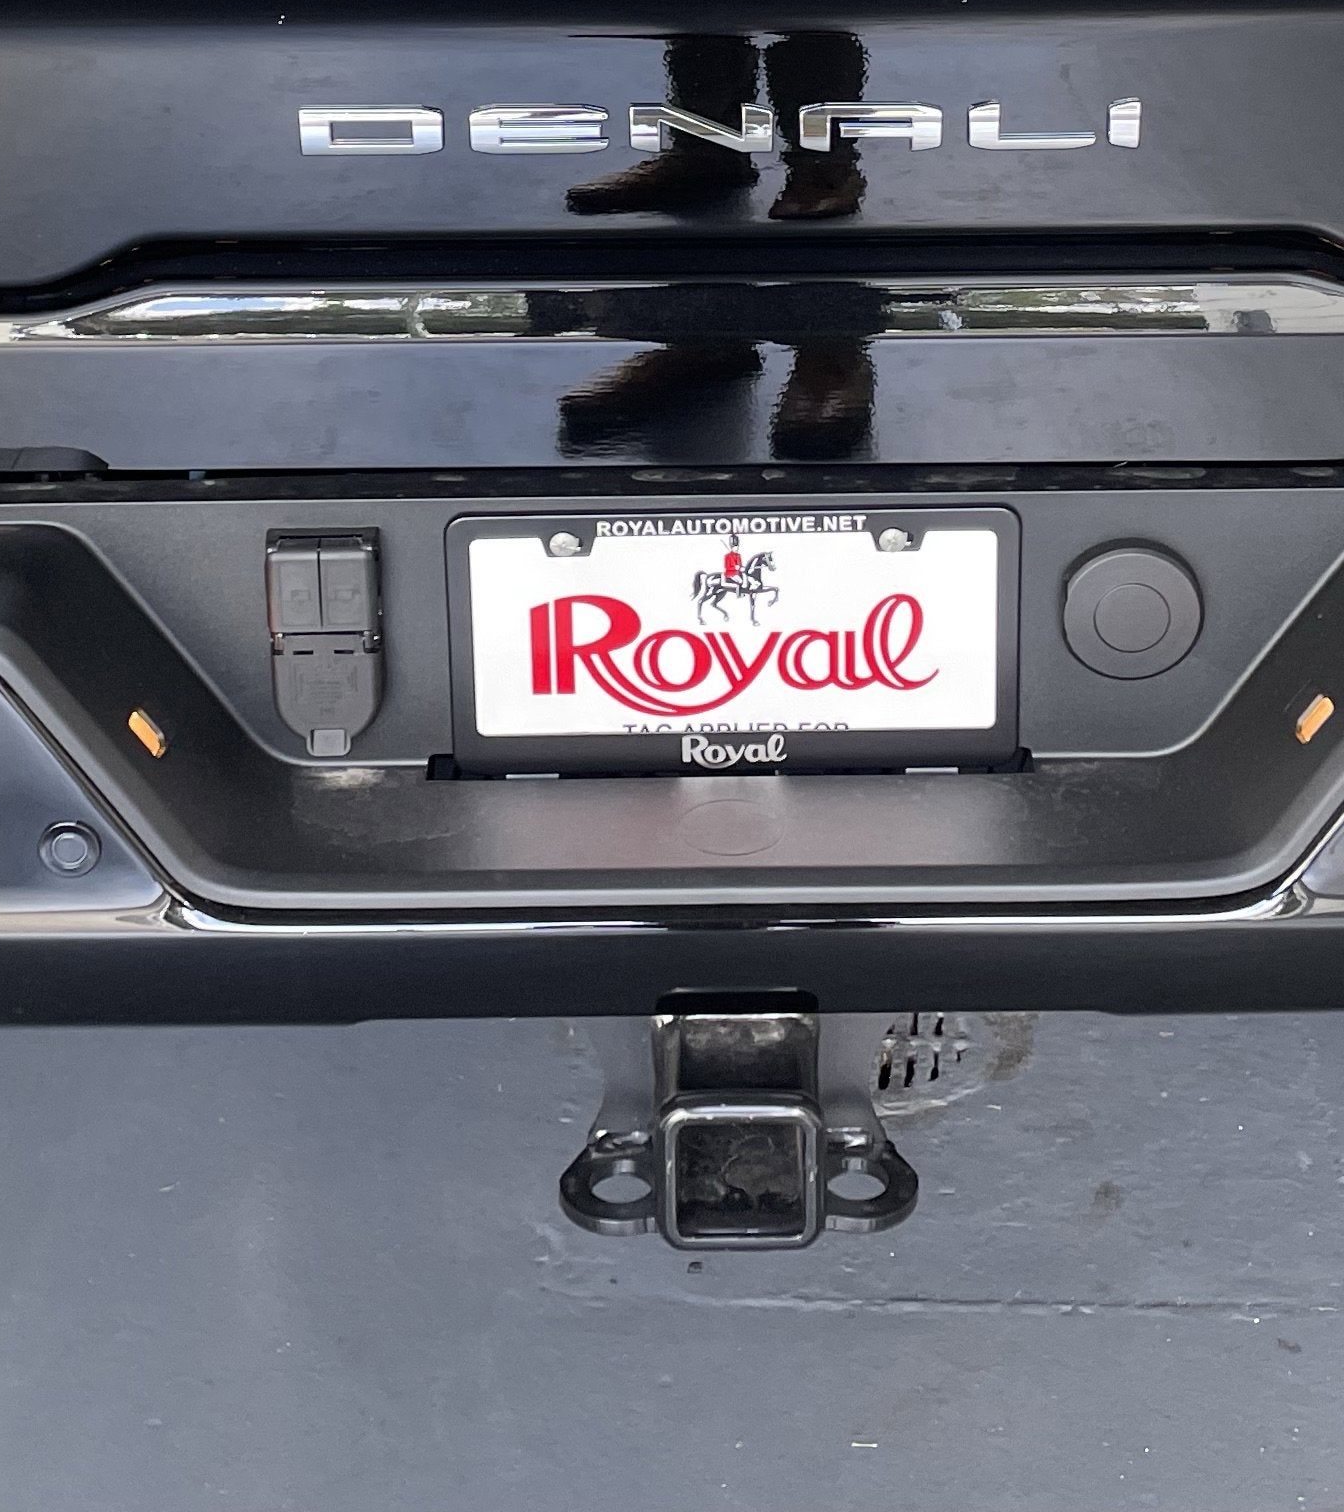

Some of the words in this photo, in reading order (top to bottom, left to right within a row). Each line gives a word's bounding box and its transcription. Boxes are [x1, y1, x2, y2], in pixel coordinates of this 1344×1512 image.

[298, 98, 1142, 156] DENALI
[596, 515, 867, 537] ROYALAUTOMOTIVE.NET
[530, 593, 940, 717] Royal
[681, 733, 788, 769] Royal
